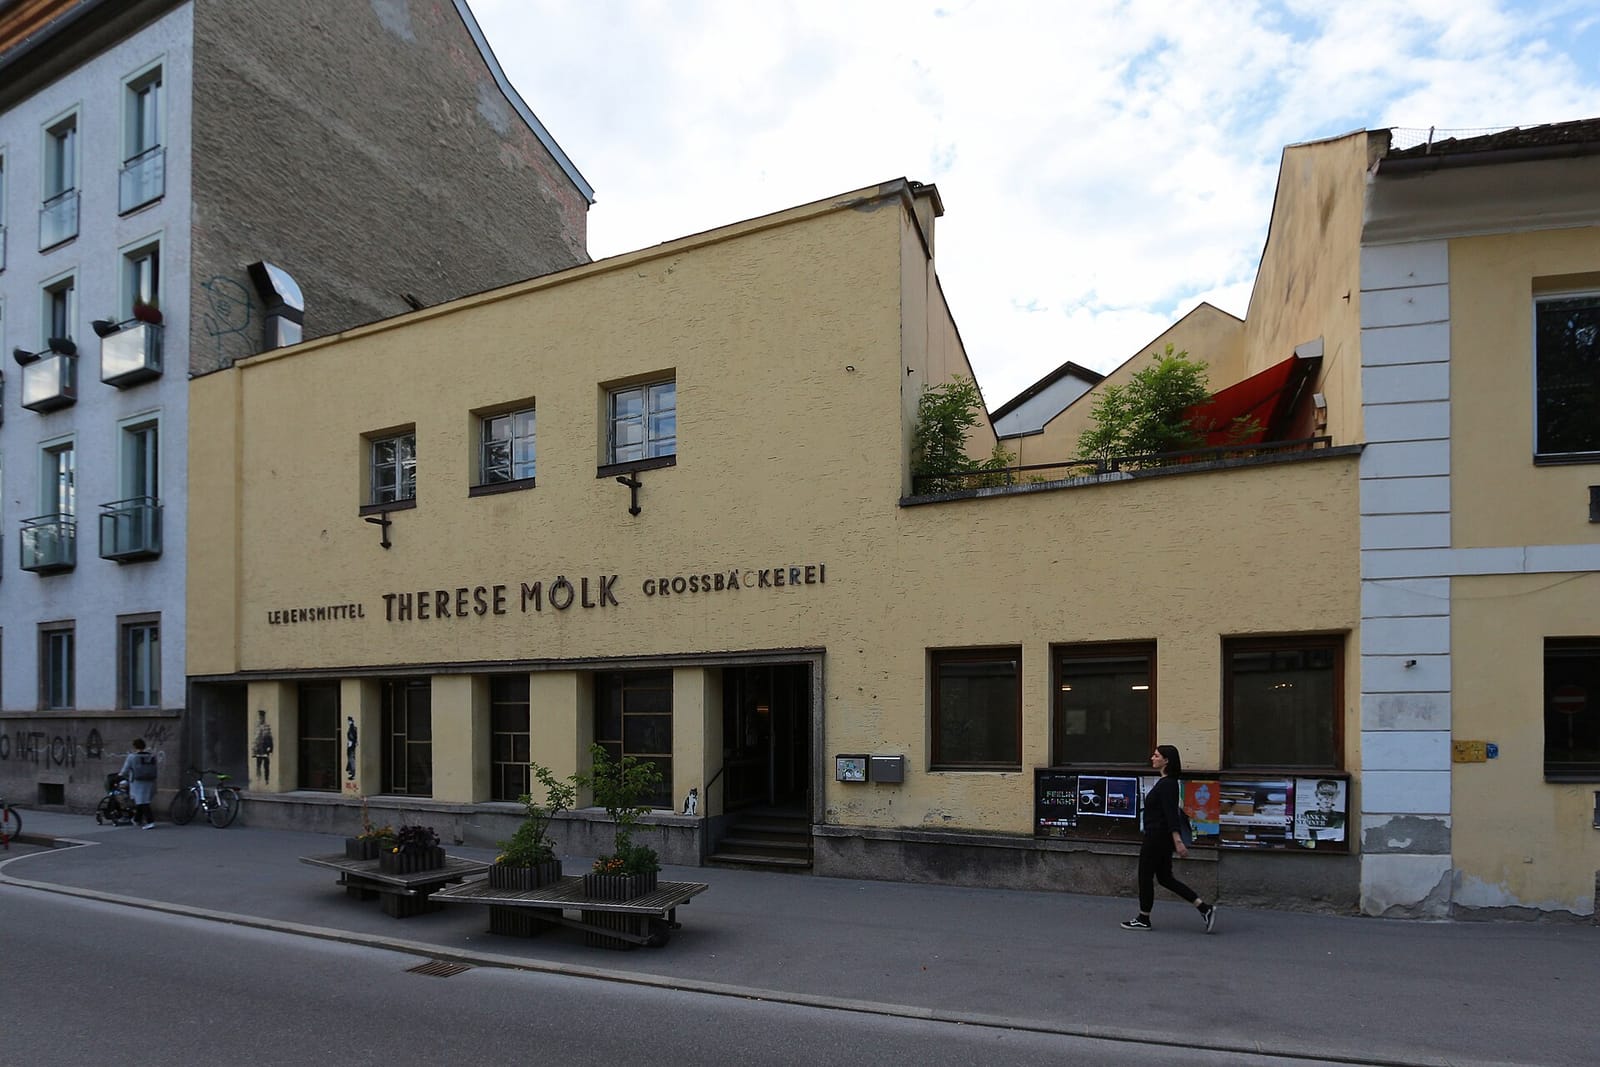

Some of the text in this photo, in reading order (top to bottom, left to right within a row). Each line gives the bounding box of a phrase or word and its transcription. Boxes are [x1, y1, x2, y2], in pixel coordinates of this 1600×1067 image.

[382, 574, 619, 621] THERESE MÖLK
[642, 562, 826, 597] GROSSBÄCKEREI
[267, 603, 365, 625] LEBENSMITTEL
[16, 731, 77, 769] NATION
